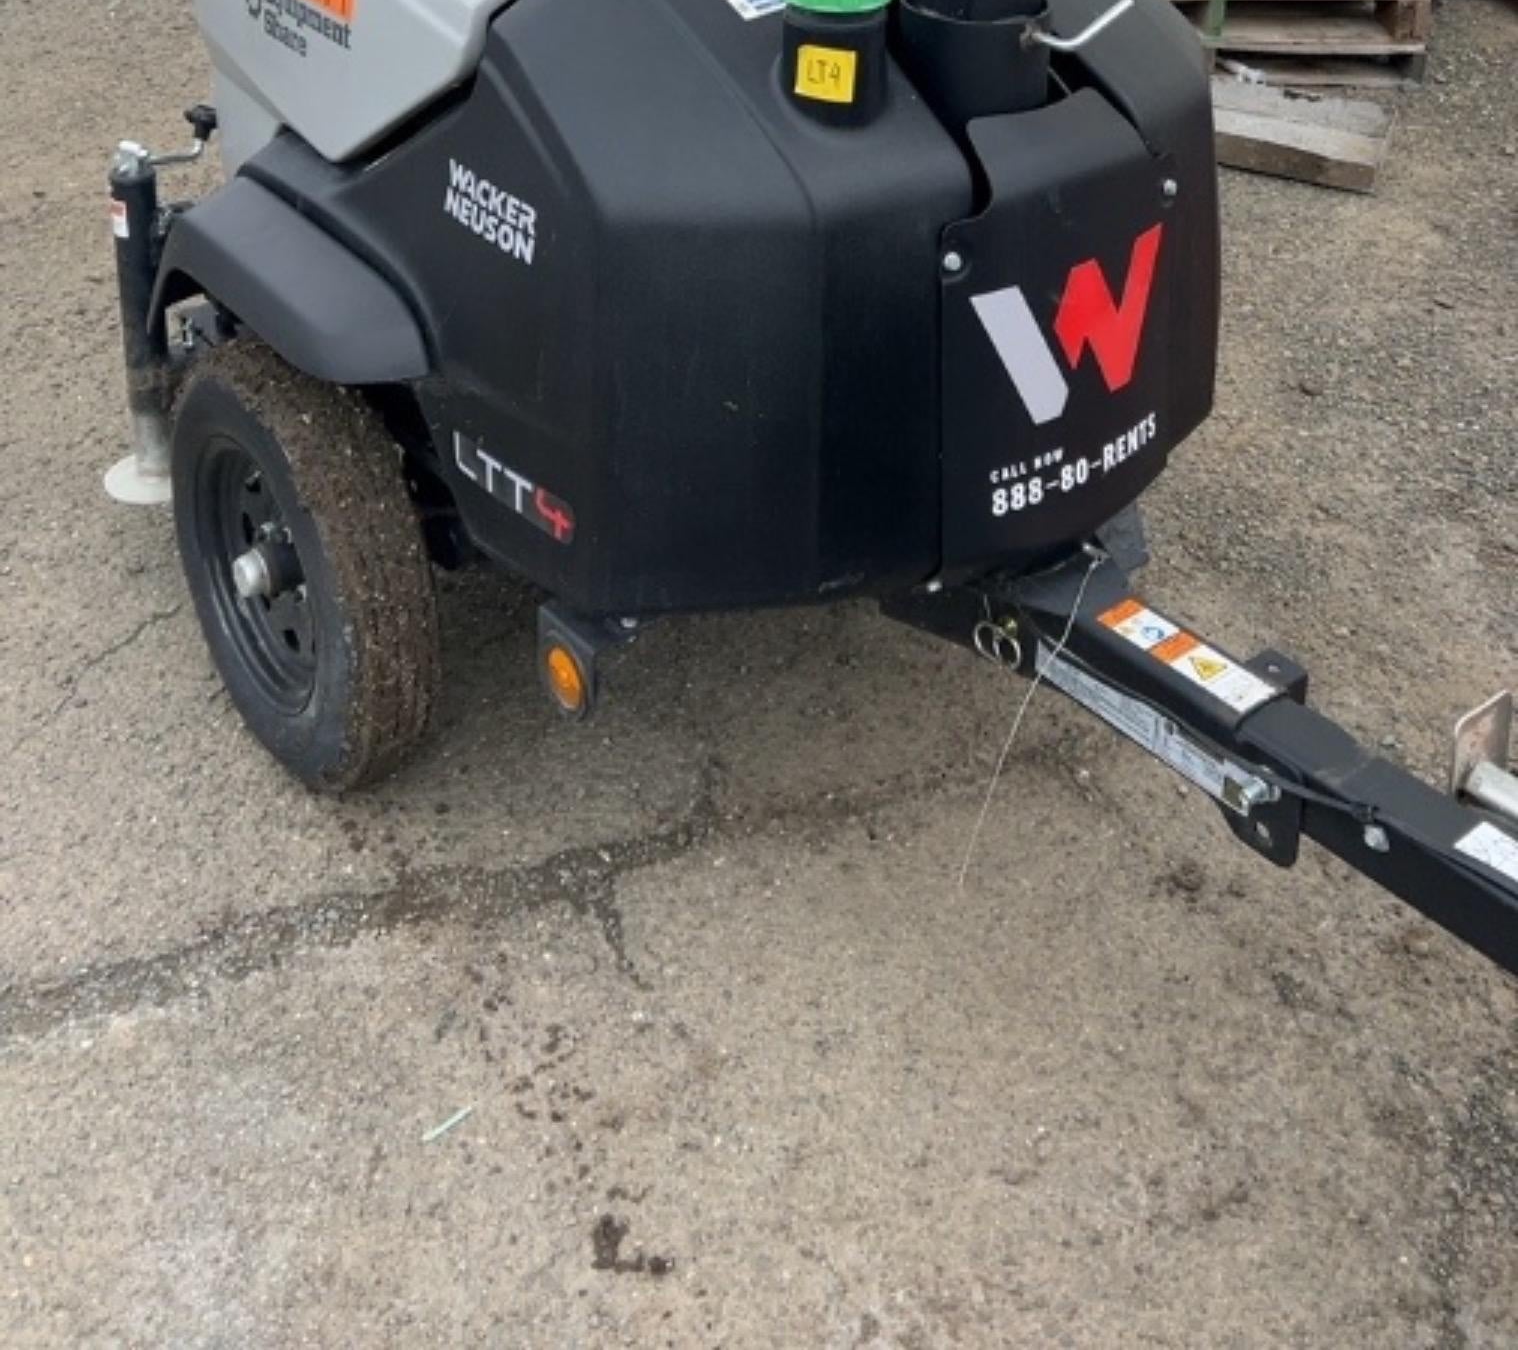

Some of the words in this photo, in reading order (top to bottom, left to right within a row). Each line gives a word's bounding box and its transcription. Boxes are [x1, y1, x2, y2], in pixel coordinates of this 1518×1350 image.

[264, 8, 307, 57] Share
[444, 186, 536, 265] NEUSON
[448, 158, 538, 237] WACKER
[452, 430, 575, 543] LTT4
[989, 460, 1028, 484] CALL
[1033, 447, 1065, 471] NOW
[991, 411, 1158, 518] 888-80-RENTS
